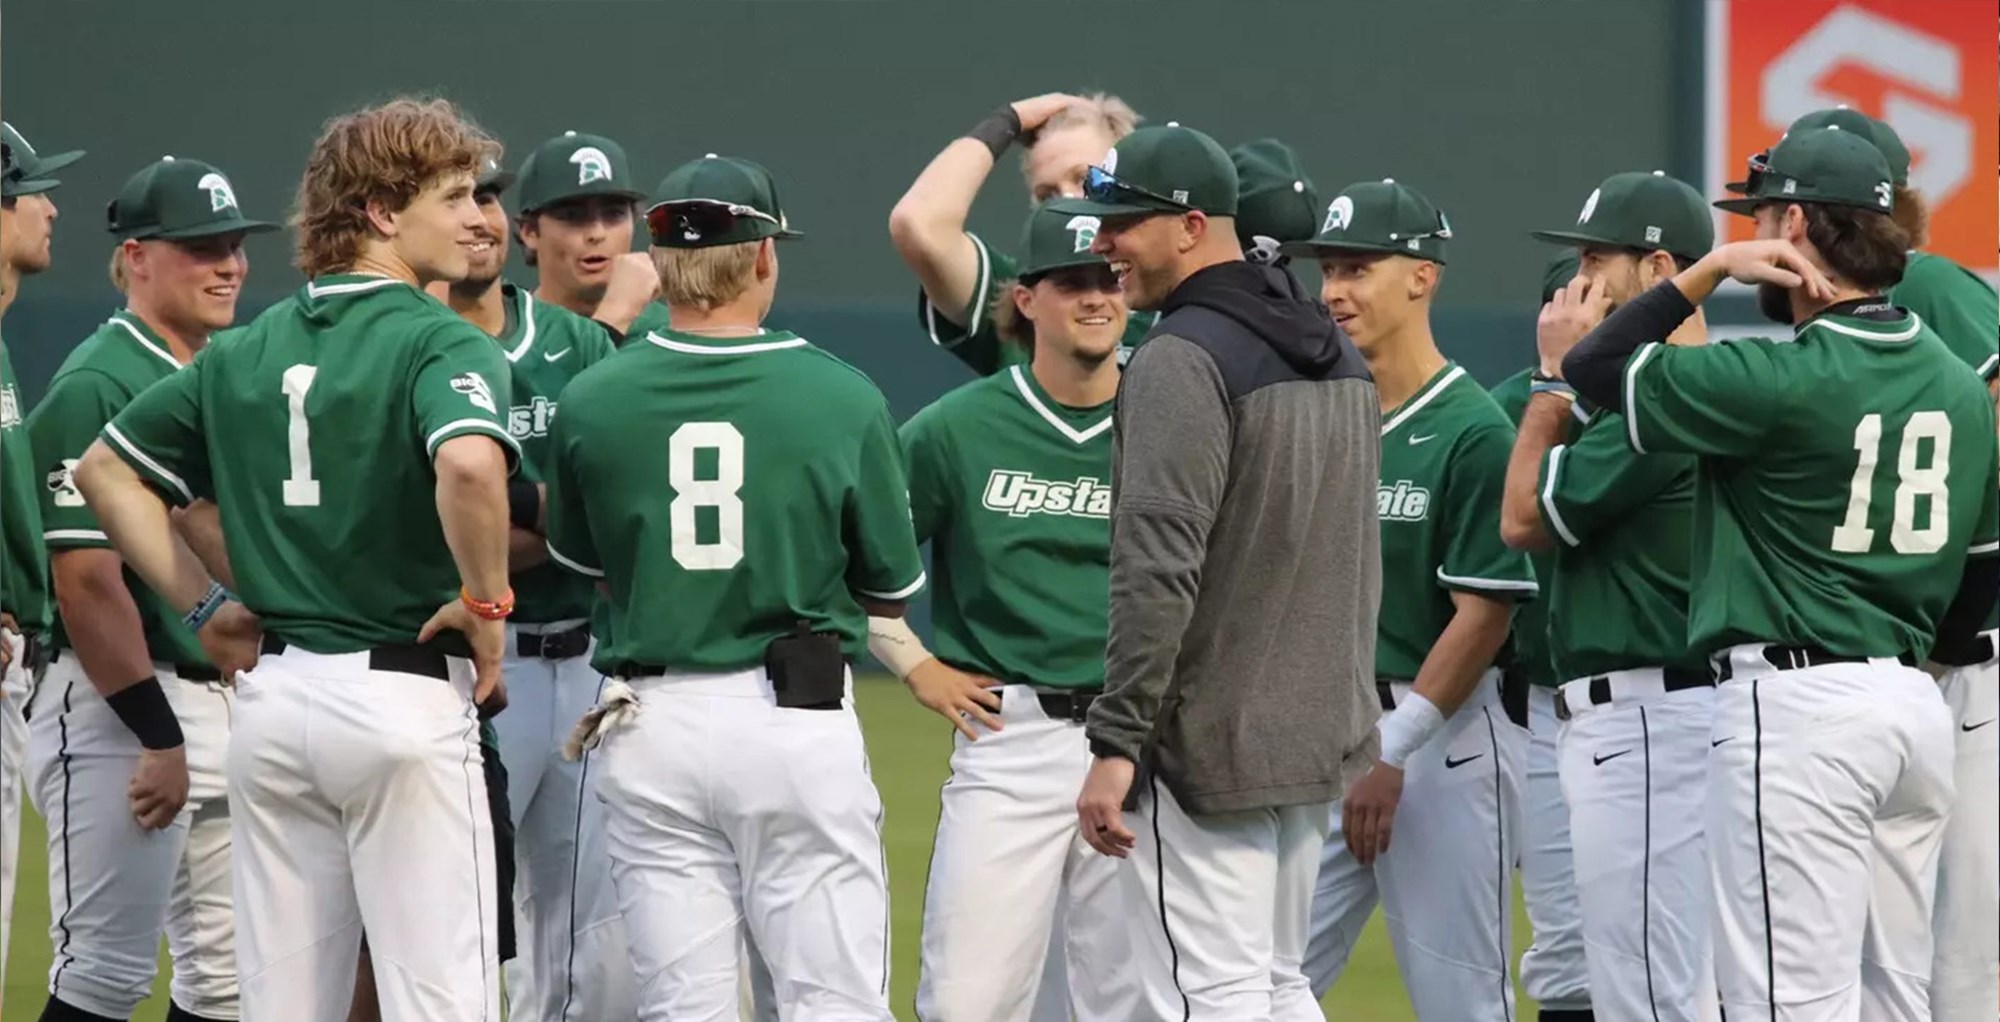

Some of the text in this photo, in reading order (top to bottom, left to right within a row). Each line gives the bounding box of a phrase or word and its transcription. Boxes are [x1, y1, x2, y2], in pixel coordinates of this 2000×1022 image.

[282, 363, 320, 506] 1
[669, 421, 744, 570] 8
[1831, 410, 1952, 554] 18
